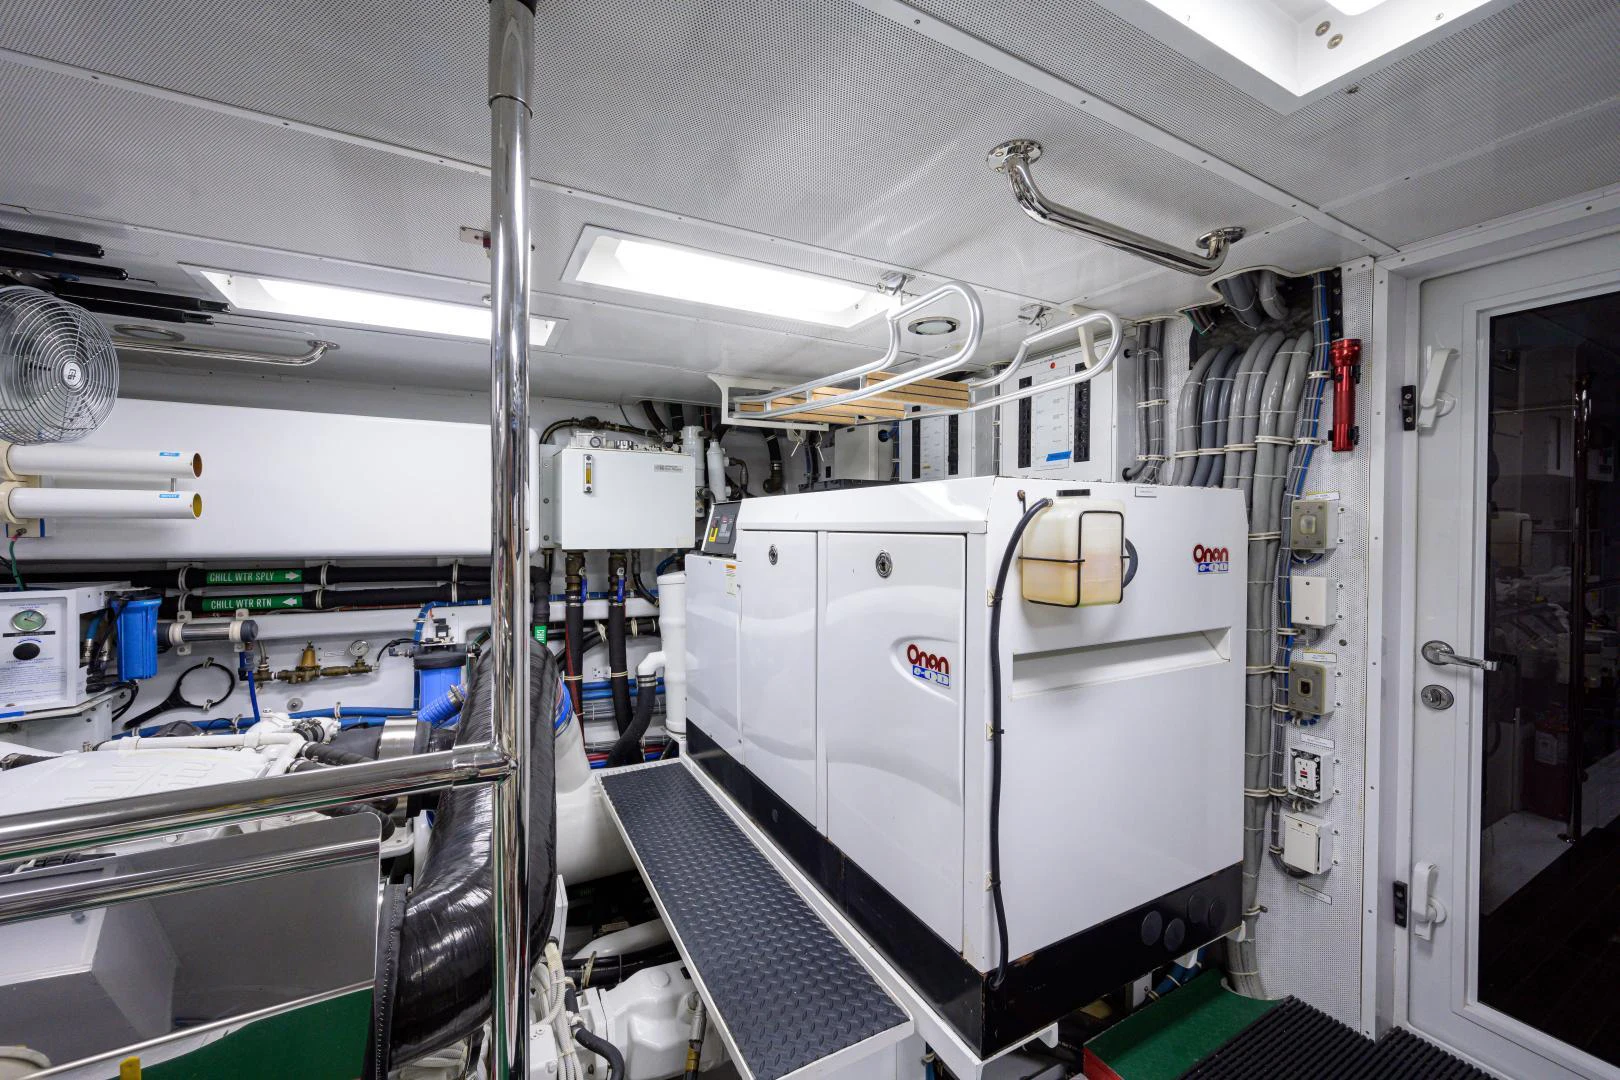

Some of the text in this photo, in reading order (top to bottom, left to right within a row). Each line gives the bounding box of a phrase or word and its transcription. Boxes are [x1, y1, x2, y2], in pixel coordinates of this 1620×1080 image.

[1193, 544, 1229, 563] Onan
[210, 571, 275, 582] CHILL WTR SPLY
[211, 598, 272, 609] CHILL WTR RTN
[536, 629, 545, 644] CHIL
[907, 643, 950, 675] Onan
